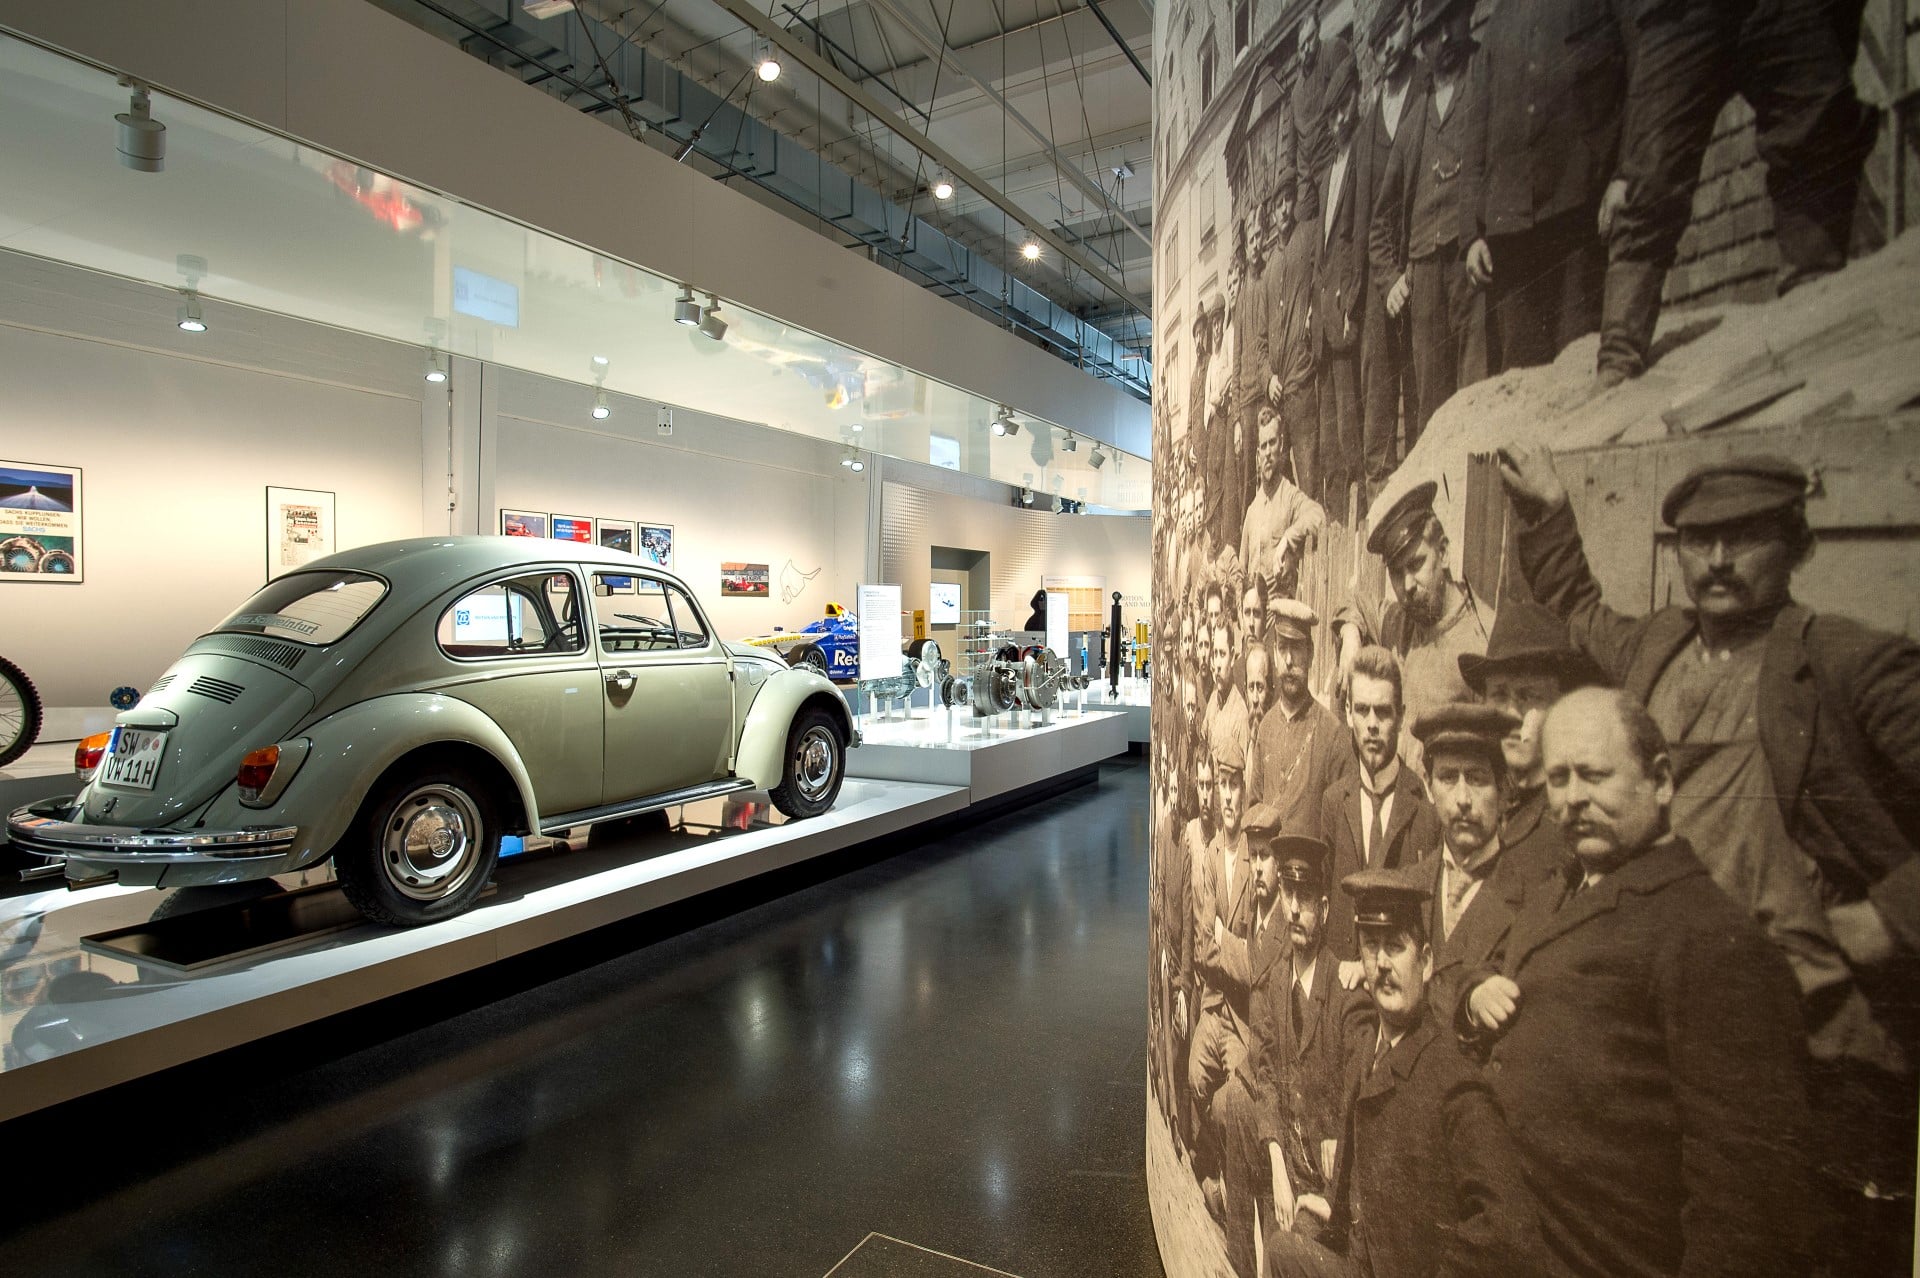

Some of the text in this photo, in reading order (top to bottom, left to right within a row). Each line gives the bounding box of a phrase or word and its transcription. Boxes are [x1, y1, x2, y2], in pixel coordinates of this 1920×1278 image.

[120, 732, 140, 755] SW
[106, 756, 156, 785] VW 11H
